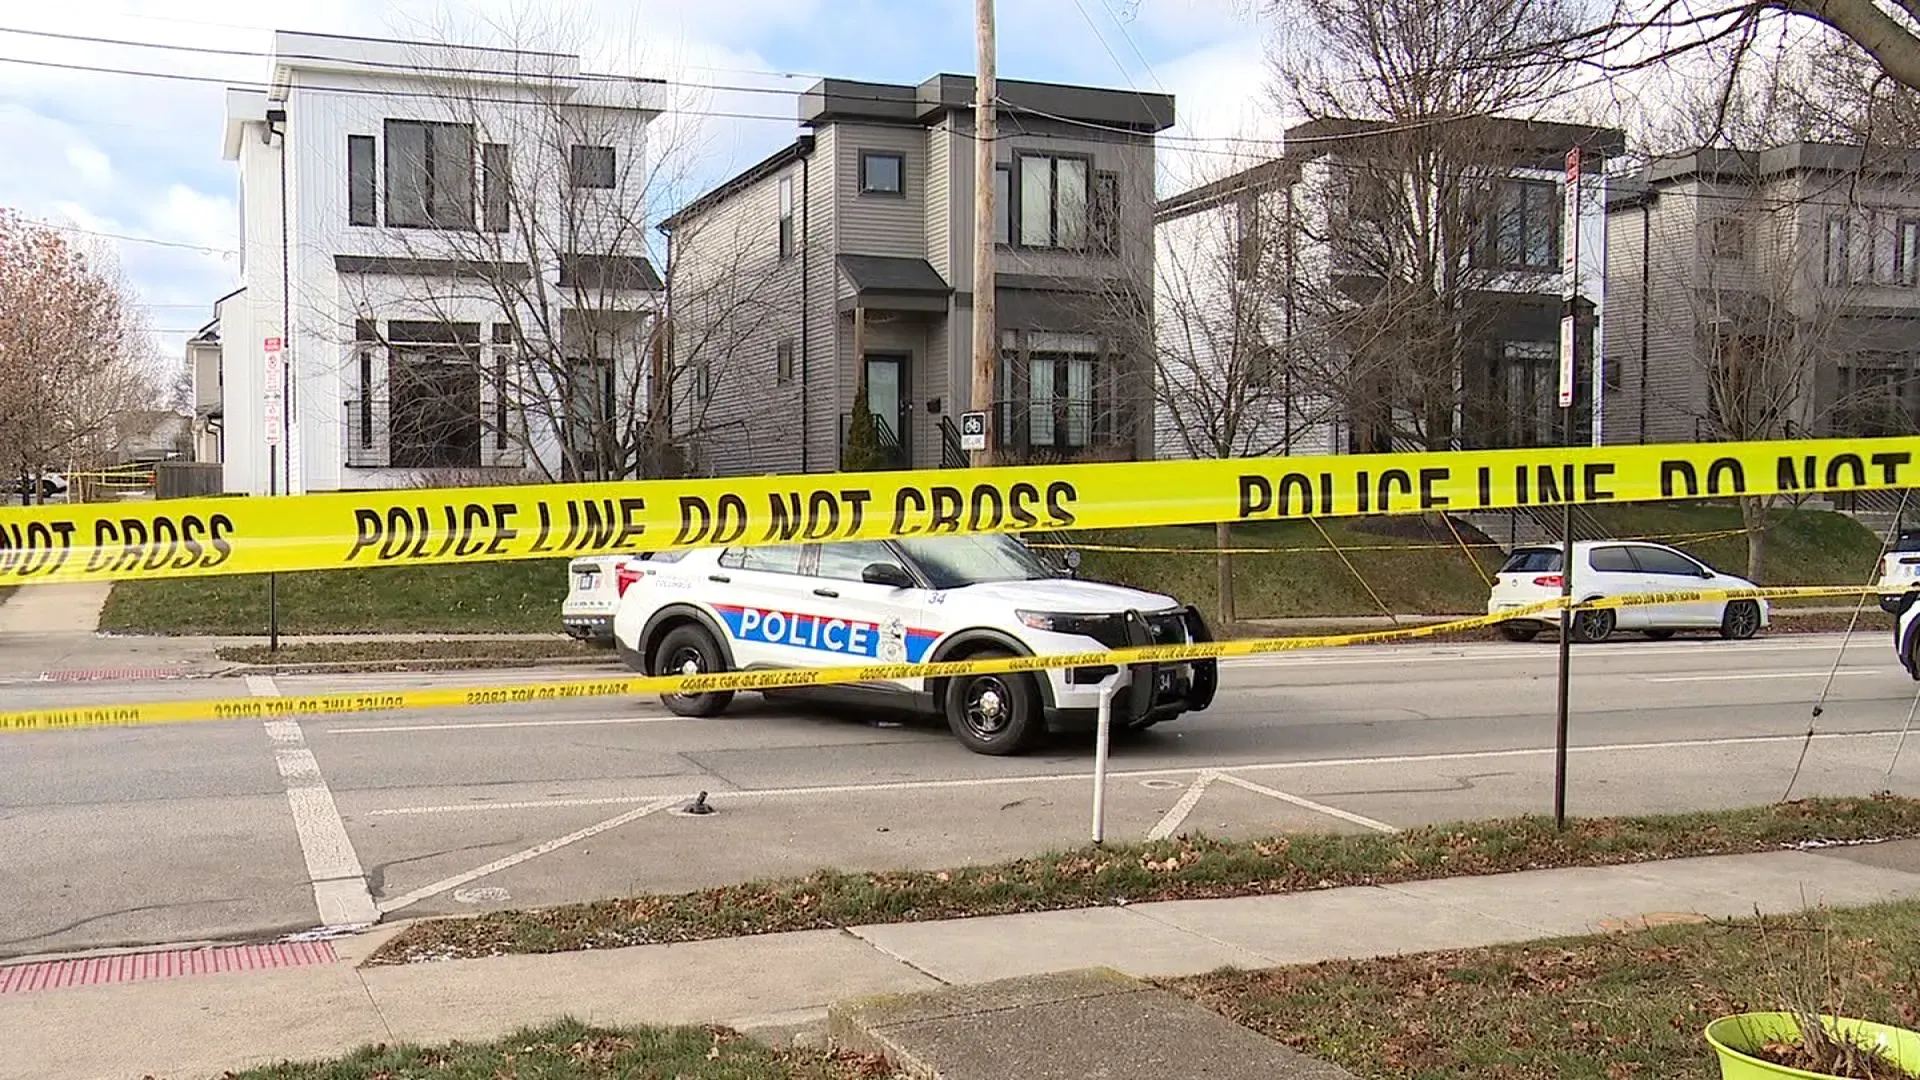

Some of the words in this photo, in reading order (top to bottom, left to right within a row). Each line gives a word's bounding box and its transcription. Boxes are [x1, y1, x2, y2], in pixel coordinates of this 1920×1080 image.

[1239, 468, 1450, 518] POLICE
[1477, 463, 1615, 506] LINE
[1661, 457, 1746, 497] DO
[1776, 452, 1912, 490] NOT
[0, 520, 76, 576] NOT
[85, 513, 235, 573] CROSS
[345, 503, 518, 561] POLICE
[529, 497, 645, 553] LINE
[672, 493, 748, 547] DO
[765, 490, 871, 542] NOT
[890, 480, 1078, 535] CROSS
[928, 592, 947, 605] 34
[739, 607, 871, 654] POLICE
